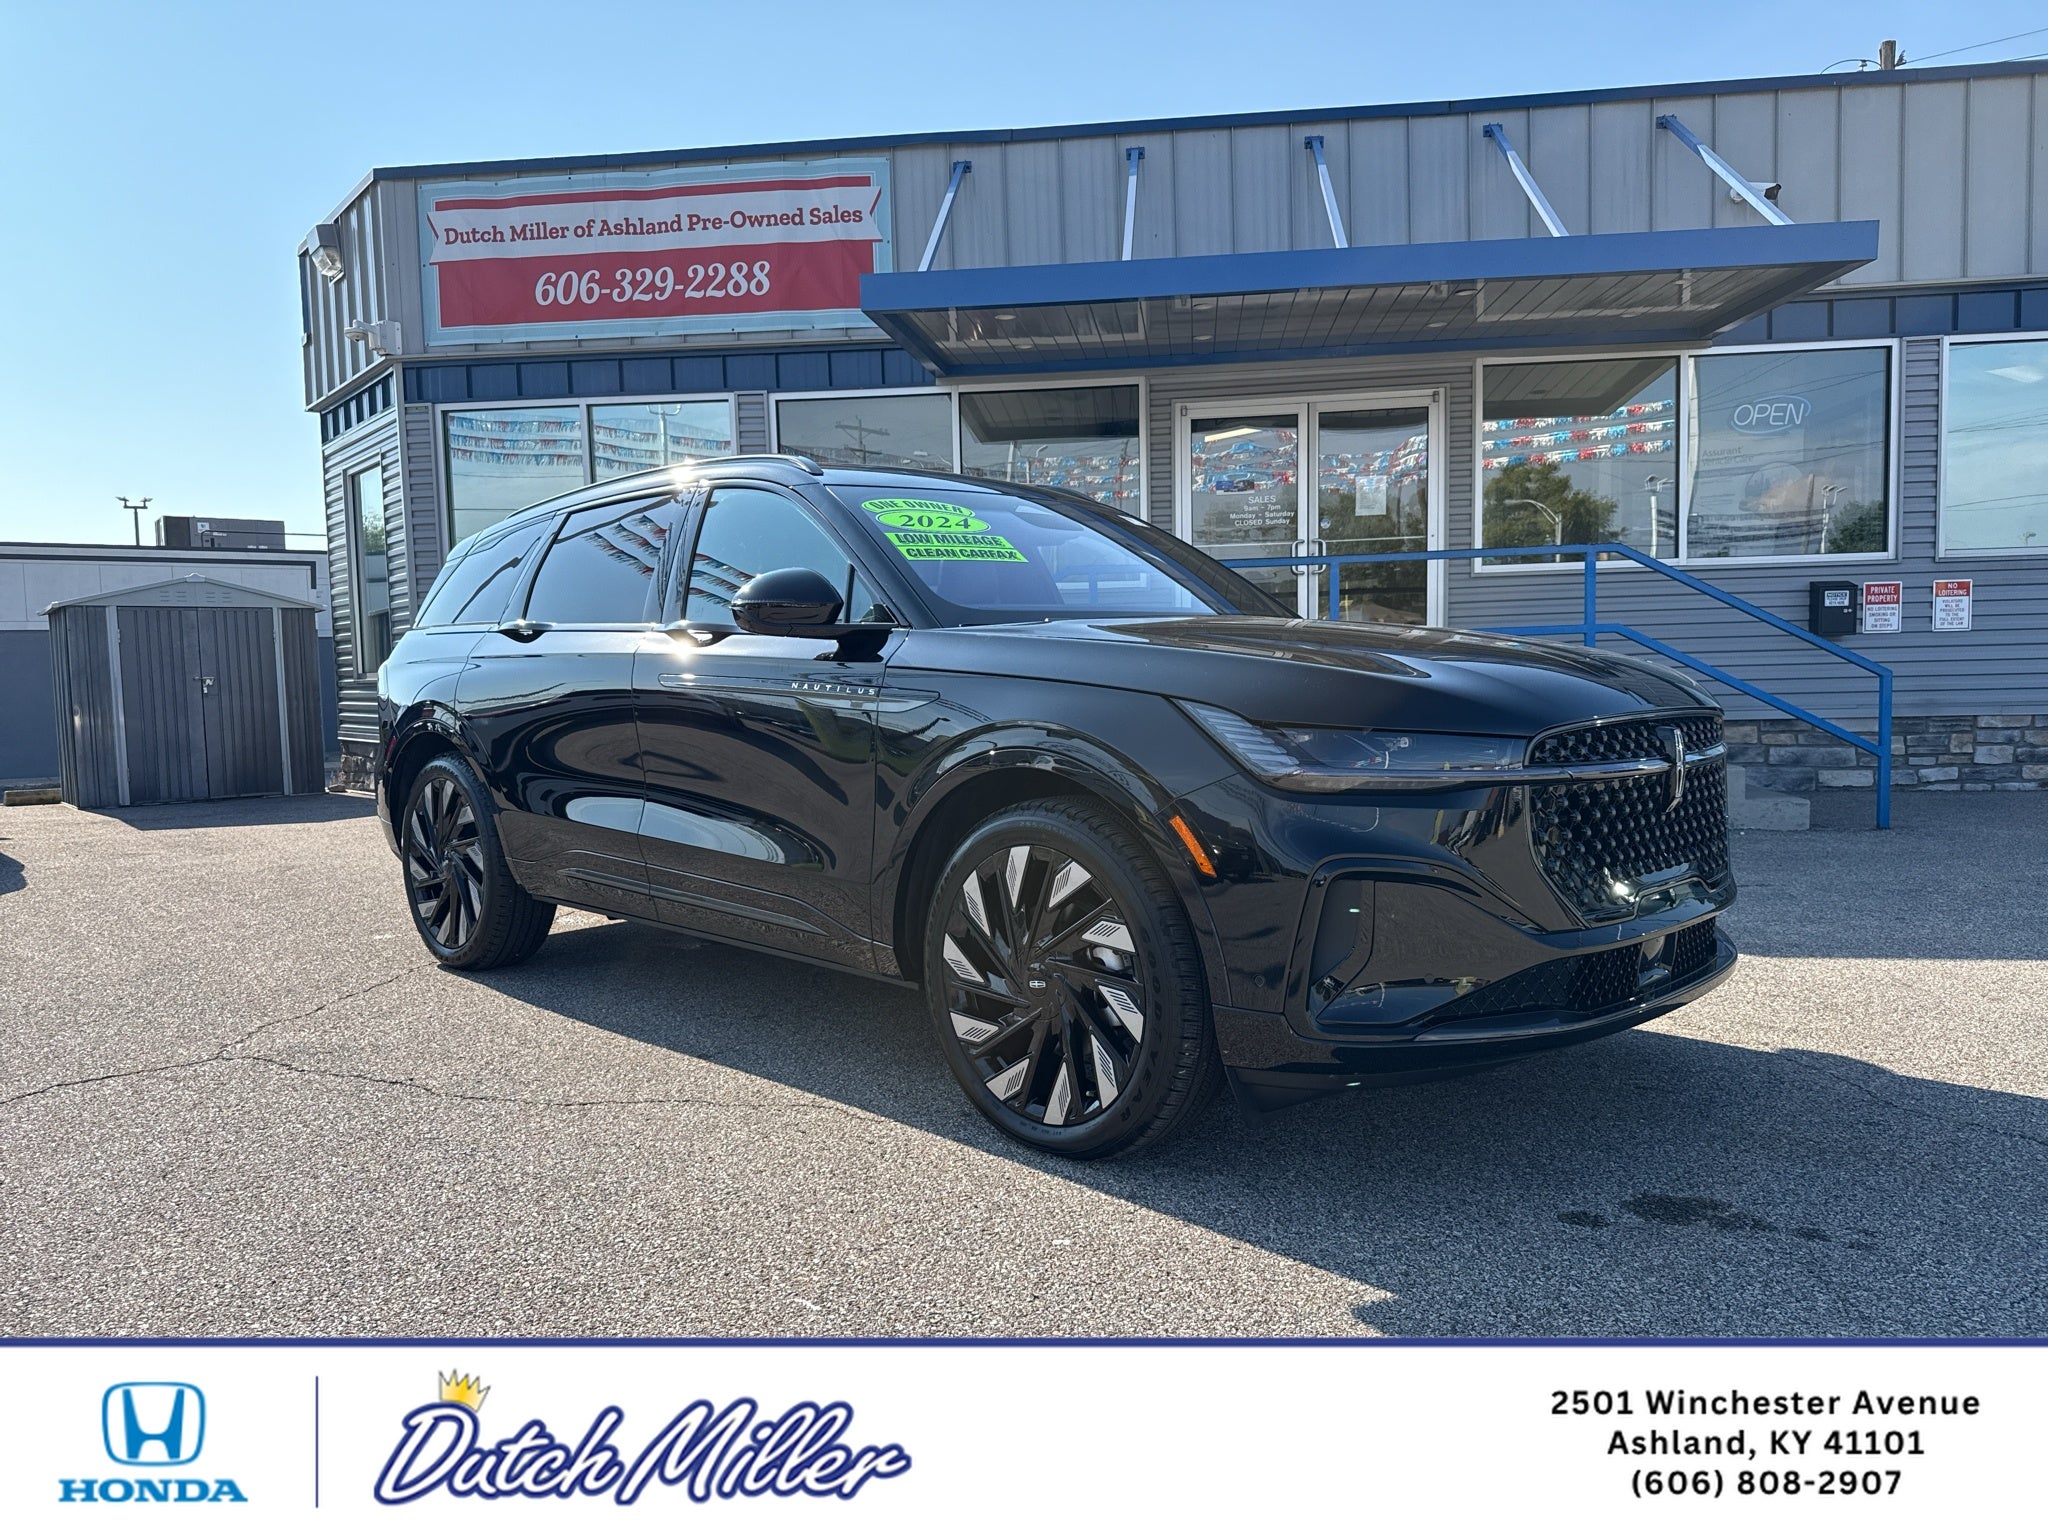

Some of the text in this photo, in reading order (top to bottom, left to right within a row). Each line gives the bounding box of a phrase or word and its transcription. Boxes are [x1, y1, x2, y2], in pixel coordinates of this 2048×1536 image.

[444, 204, 863, 246] Dutch Miller of Ashland Pre-Owned Sales
[534, 260, 771, 307] 606-329-2288
[1733, 403, 1805, 426] OPEN
[1248, 495, 1276, 504] SALES
[869, 499, 963, 515] ONE OWNER
[1264, 510, 1295, 518] Saturday
[898, 514, 971, 530] 2024
[1234, 519, 1263, 527] CLOSED
[895, 533, 1004, 547] LOW MILEAGE
[906, 548, 1018, 561] CLEAN CARFAX
[1870, 586, 1895, 594] PRIVATE
[1867, 594, 1898, 603] PROPERTY
[791, 682, 875, 695] NAUTILUS
